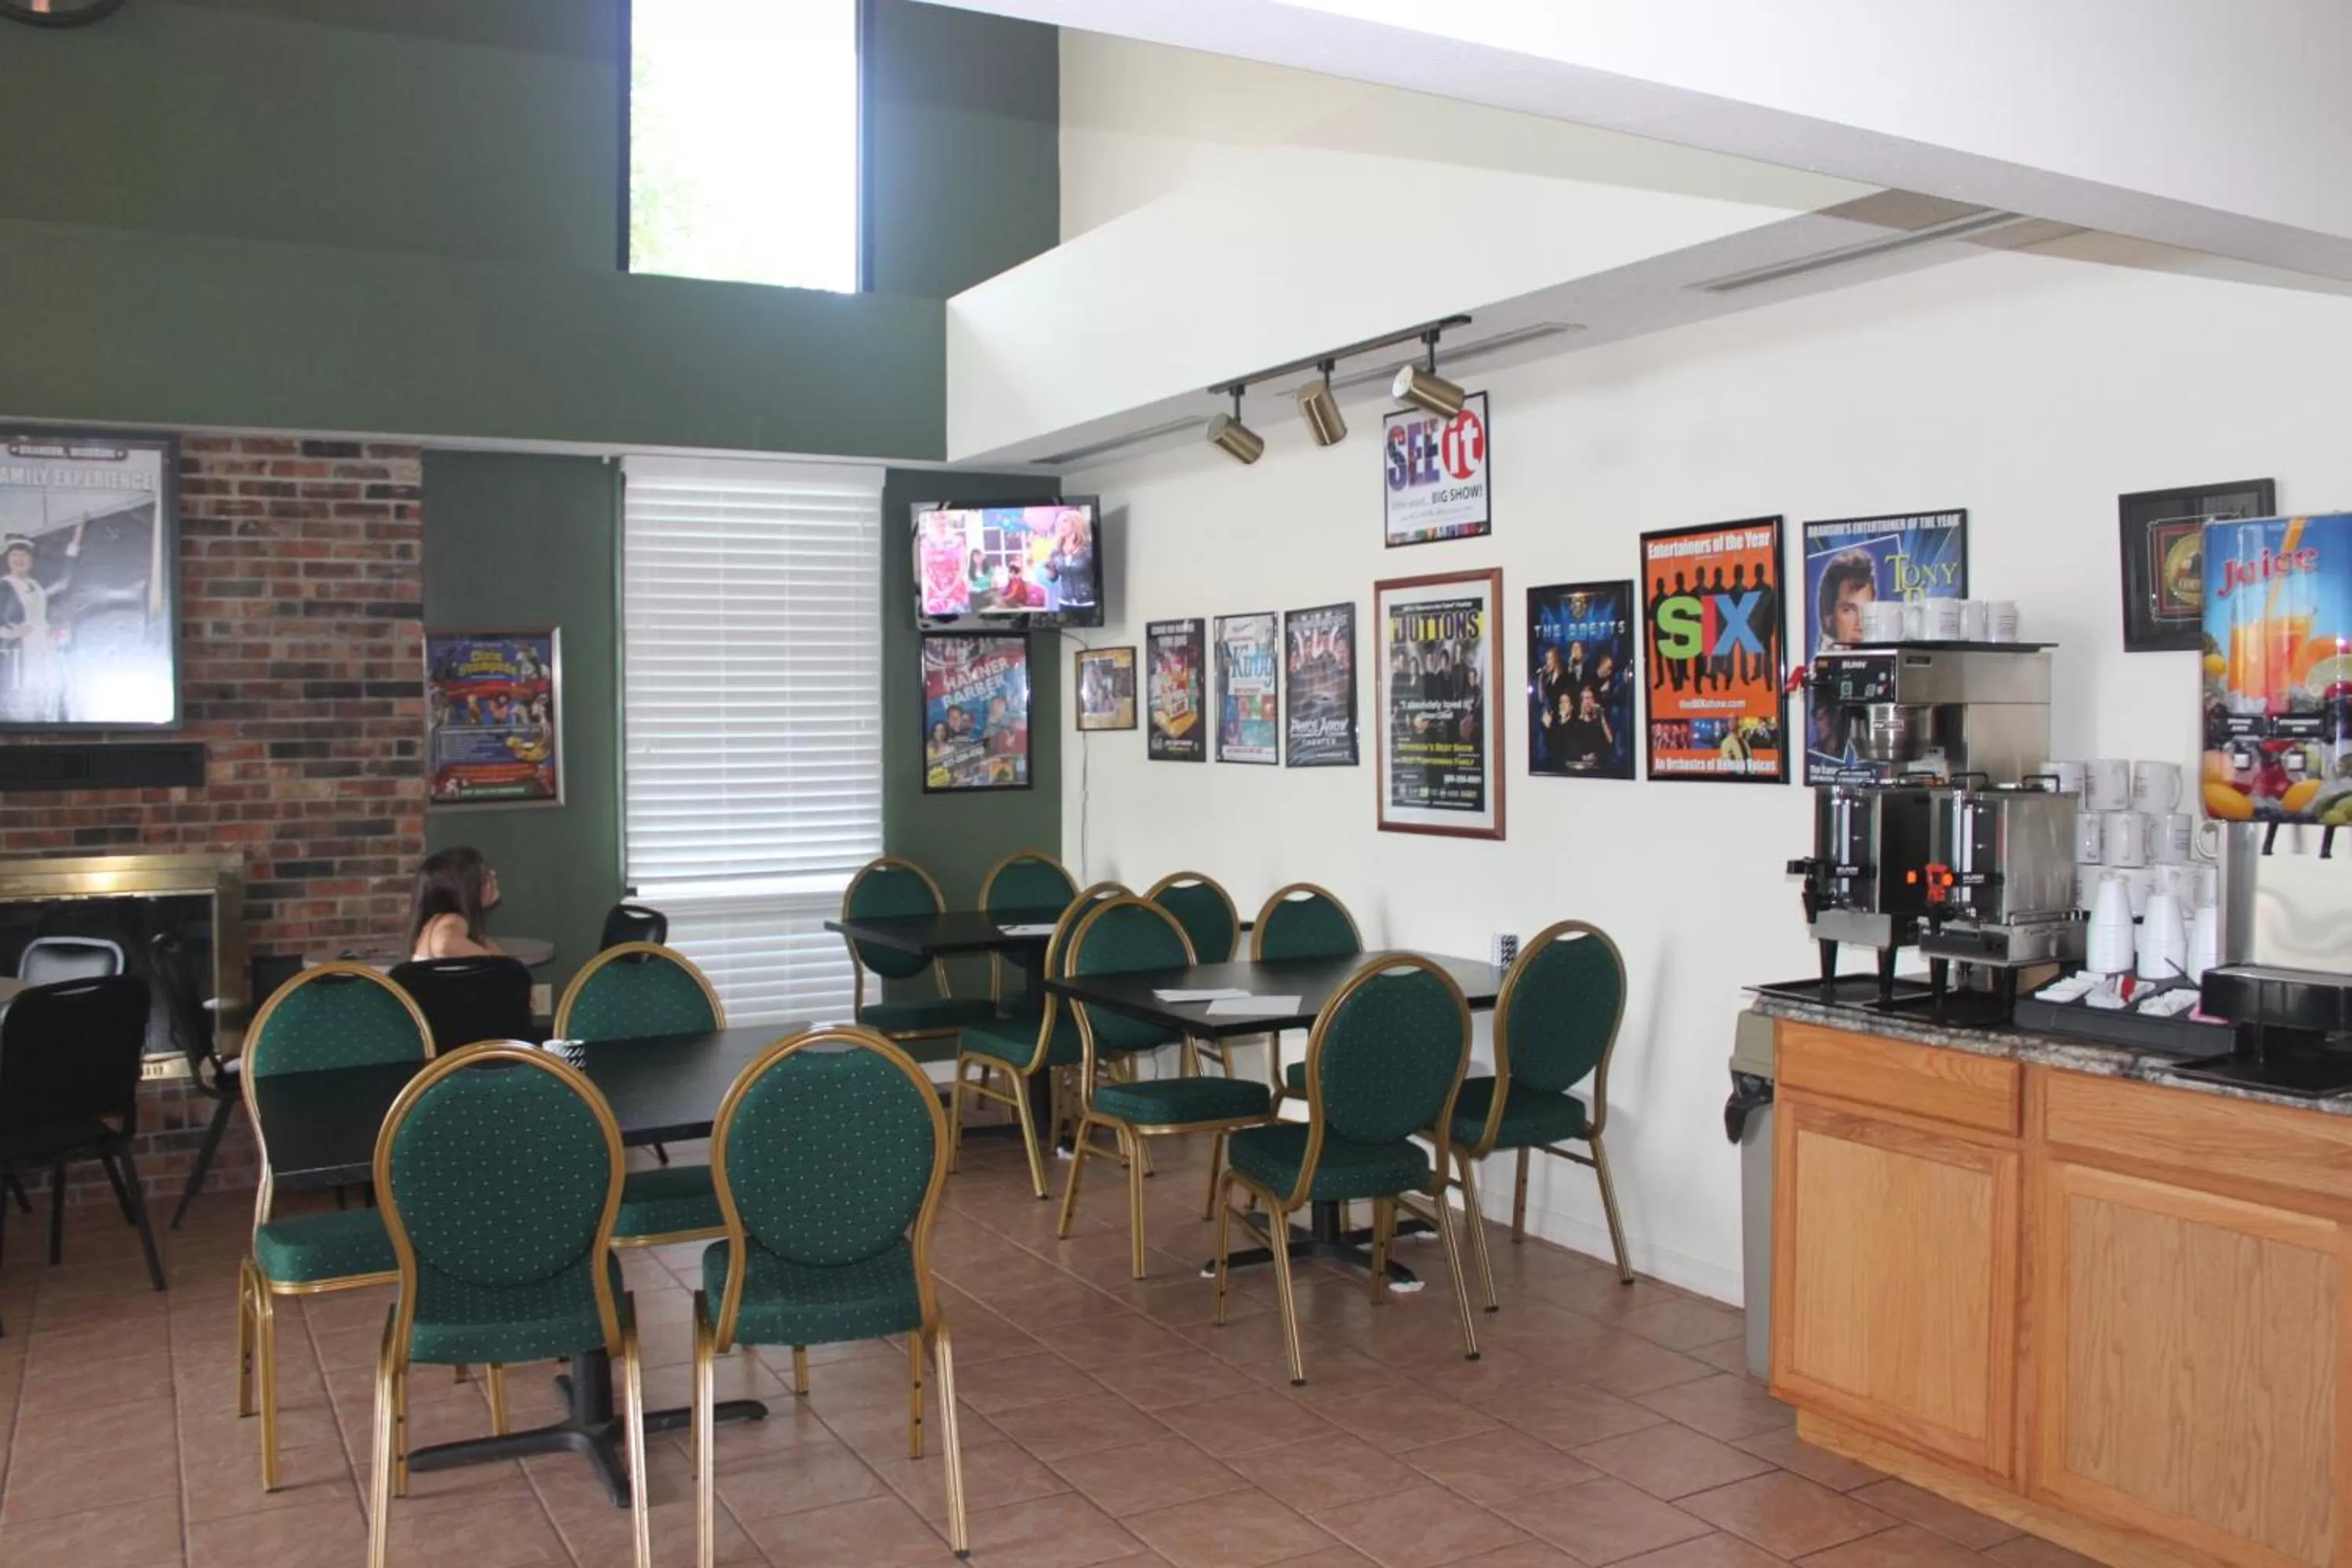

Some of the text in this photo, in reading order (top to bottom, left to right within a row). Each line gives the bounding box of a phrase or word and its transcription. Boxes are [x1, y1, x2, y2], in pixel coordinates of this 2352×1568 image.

[1387, 418, 1480, 492] SEE it
[0, 467, 49, 485] AMILY
[1432, 491, 1448, 503] BIG
[1450, 485, 1483, 500] SHOW!
[1648, 530, 1771, 560] Entertainers of the Year
[1885, 553, 1958, 593] TONY
[2217, 546, 2318, 598] Juice
[1534, 624, 1562, 637] THE
[1657, 591, 1765, 659] SIX
